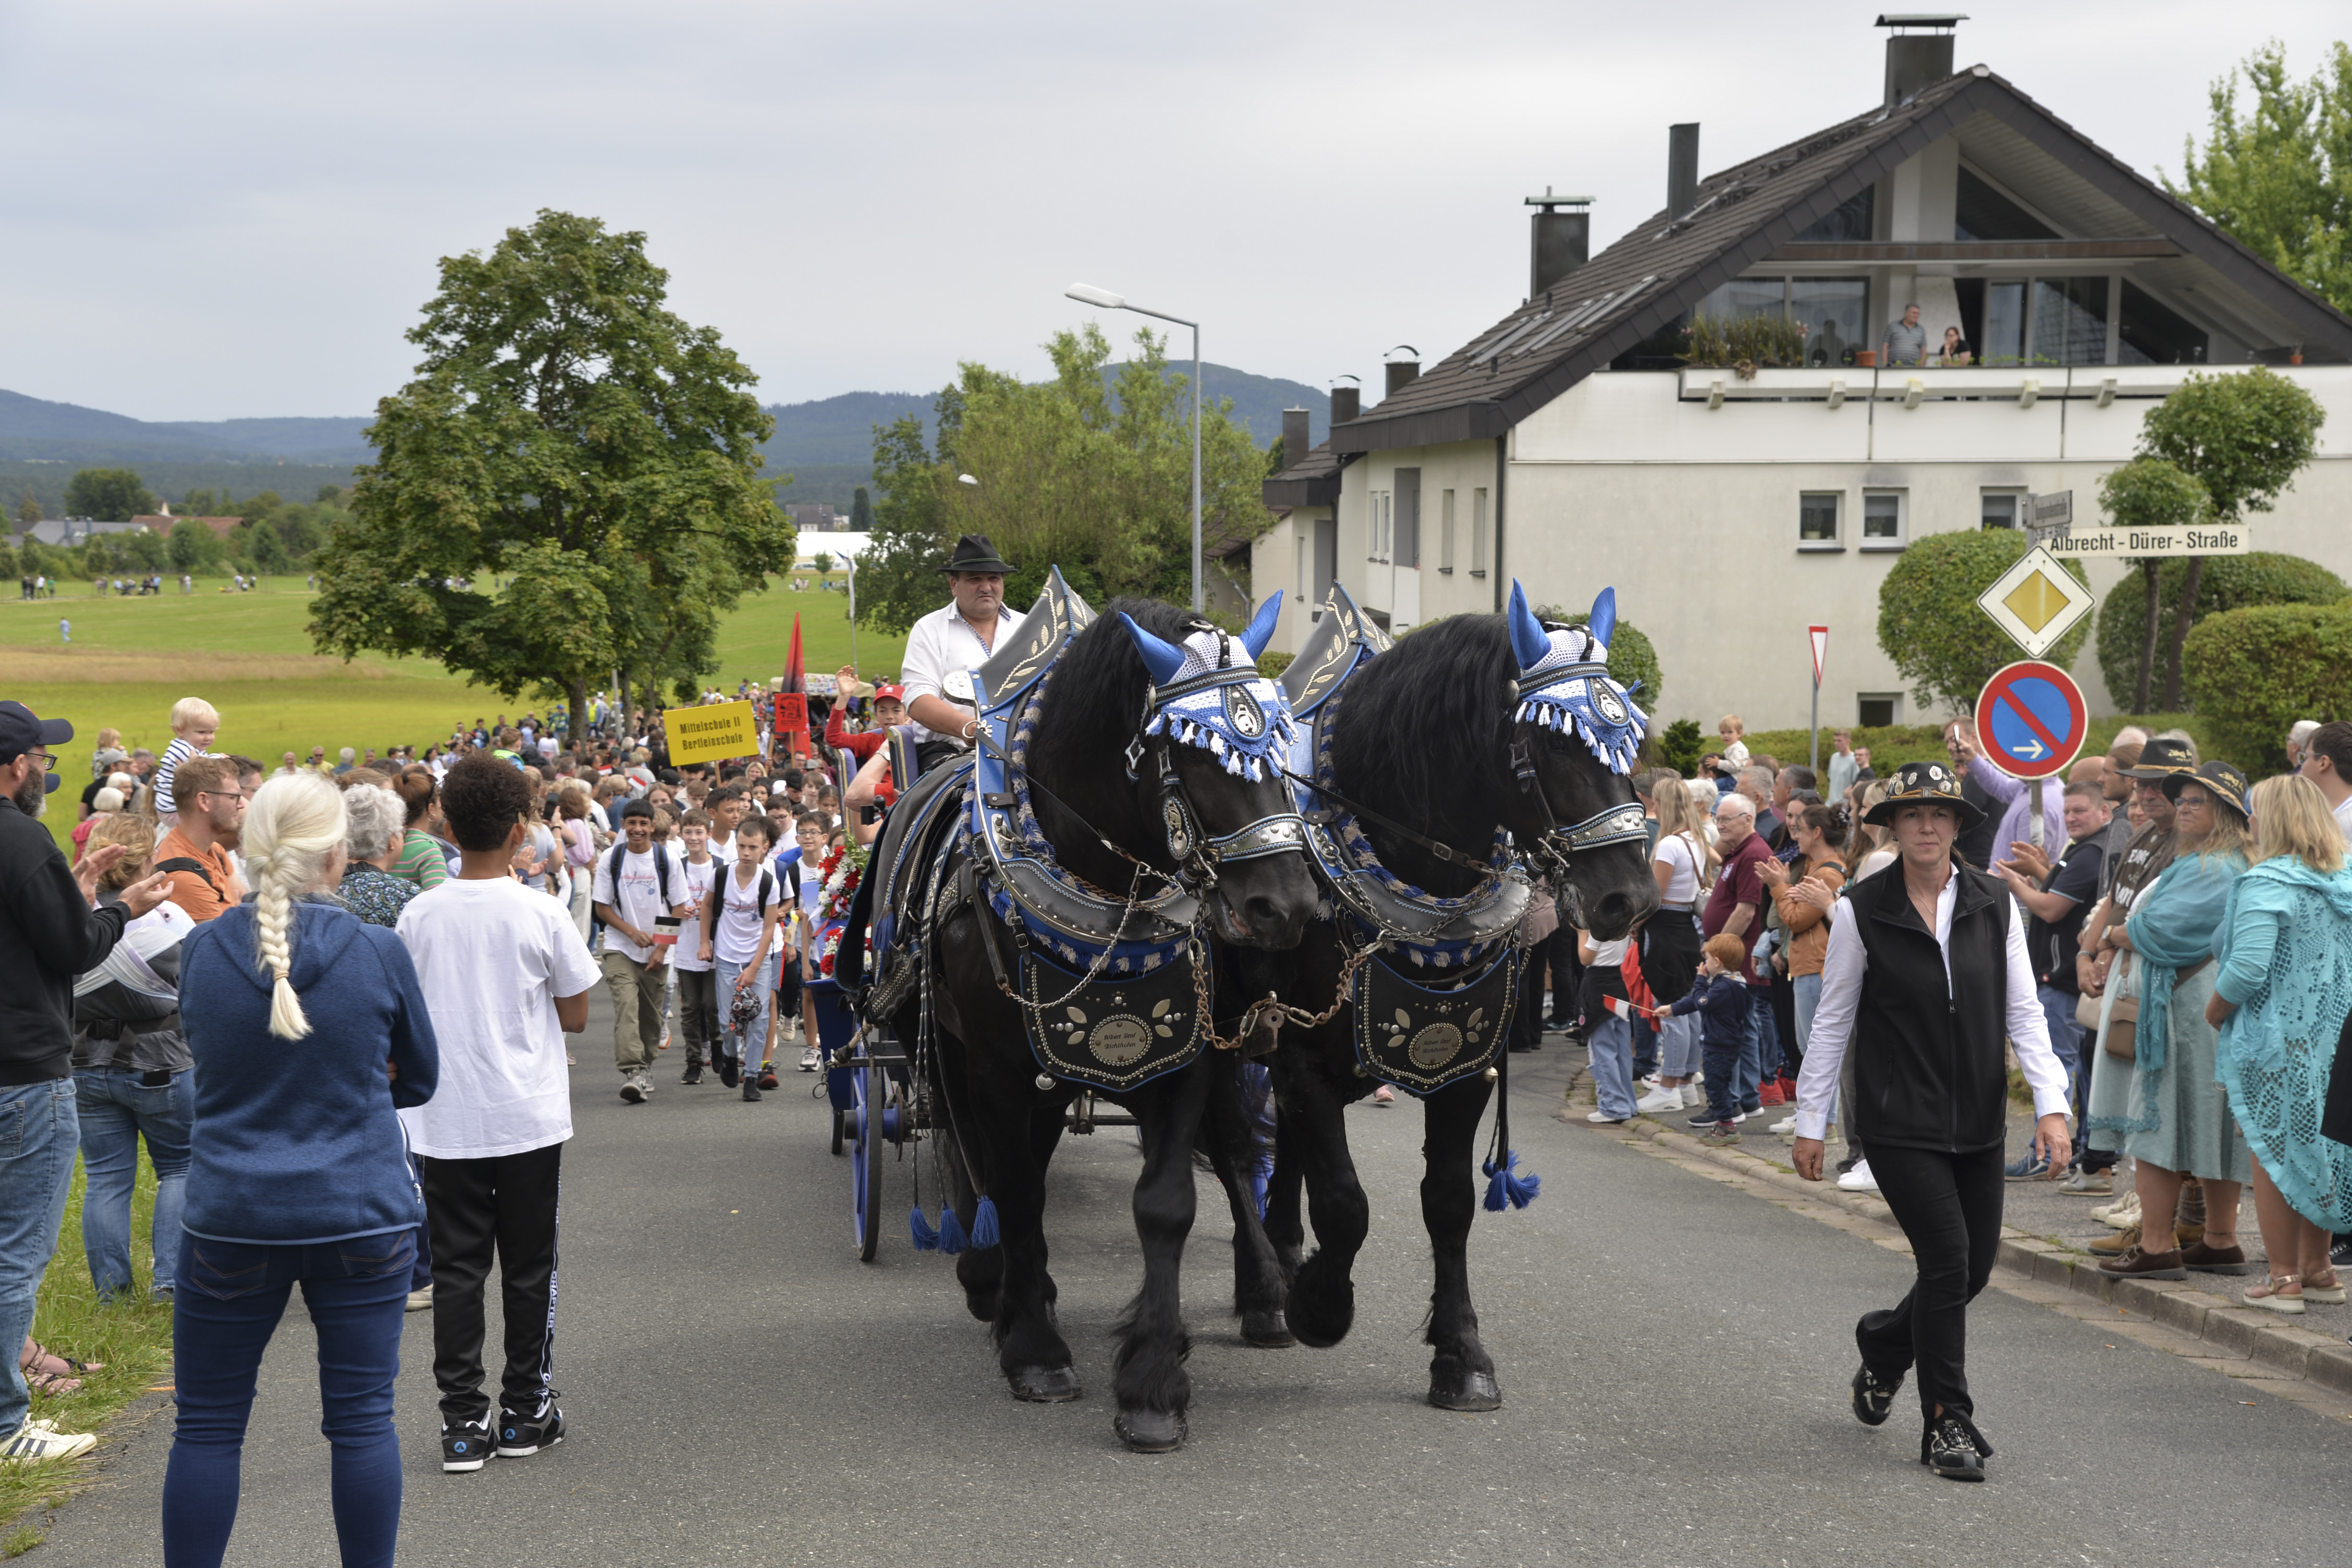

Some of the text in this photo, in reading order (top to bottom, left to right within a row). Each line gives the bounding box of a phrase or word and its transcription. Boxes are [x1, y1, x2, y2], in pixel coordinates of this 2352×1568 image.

[680, 716, 740, 734] Mittelschule II
[682, 733, 743, 750] Bertleinschule
